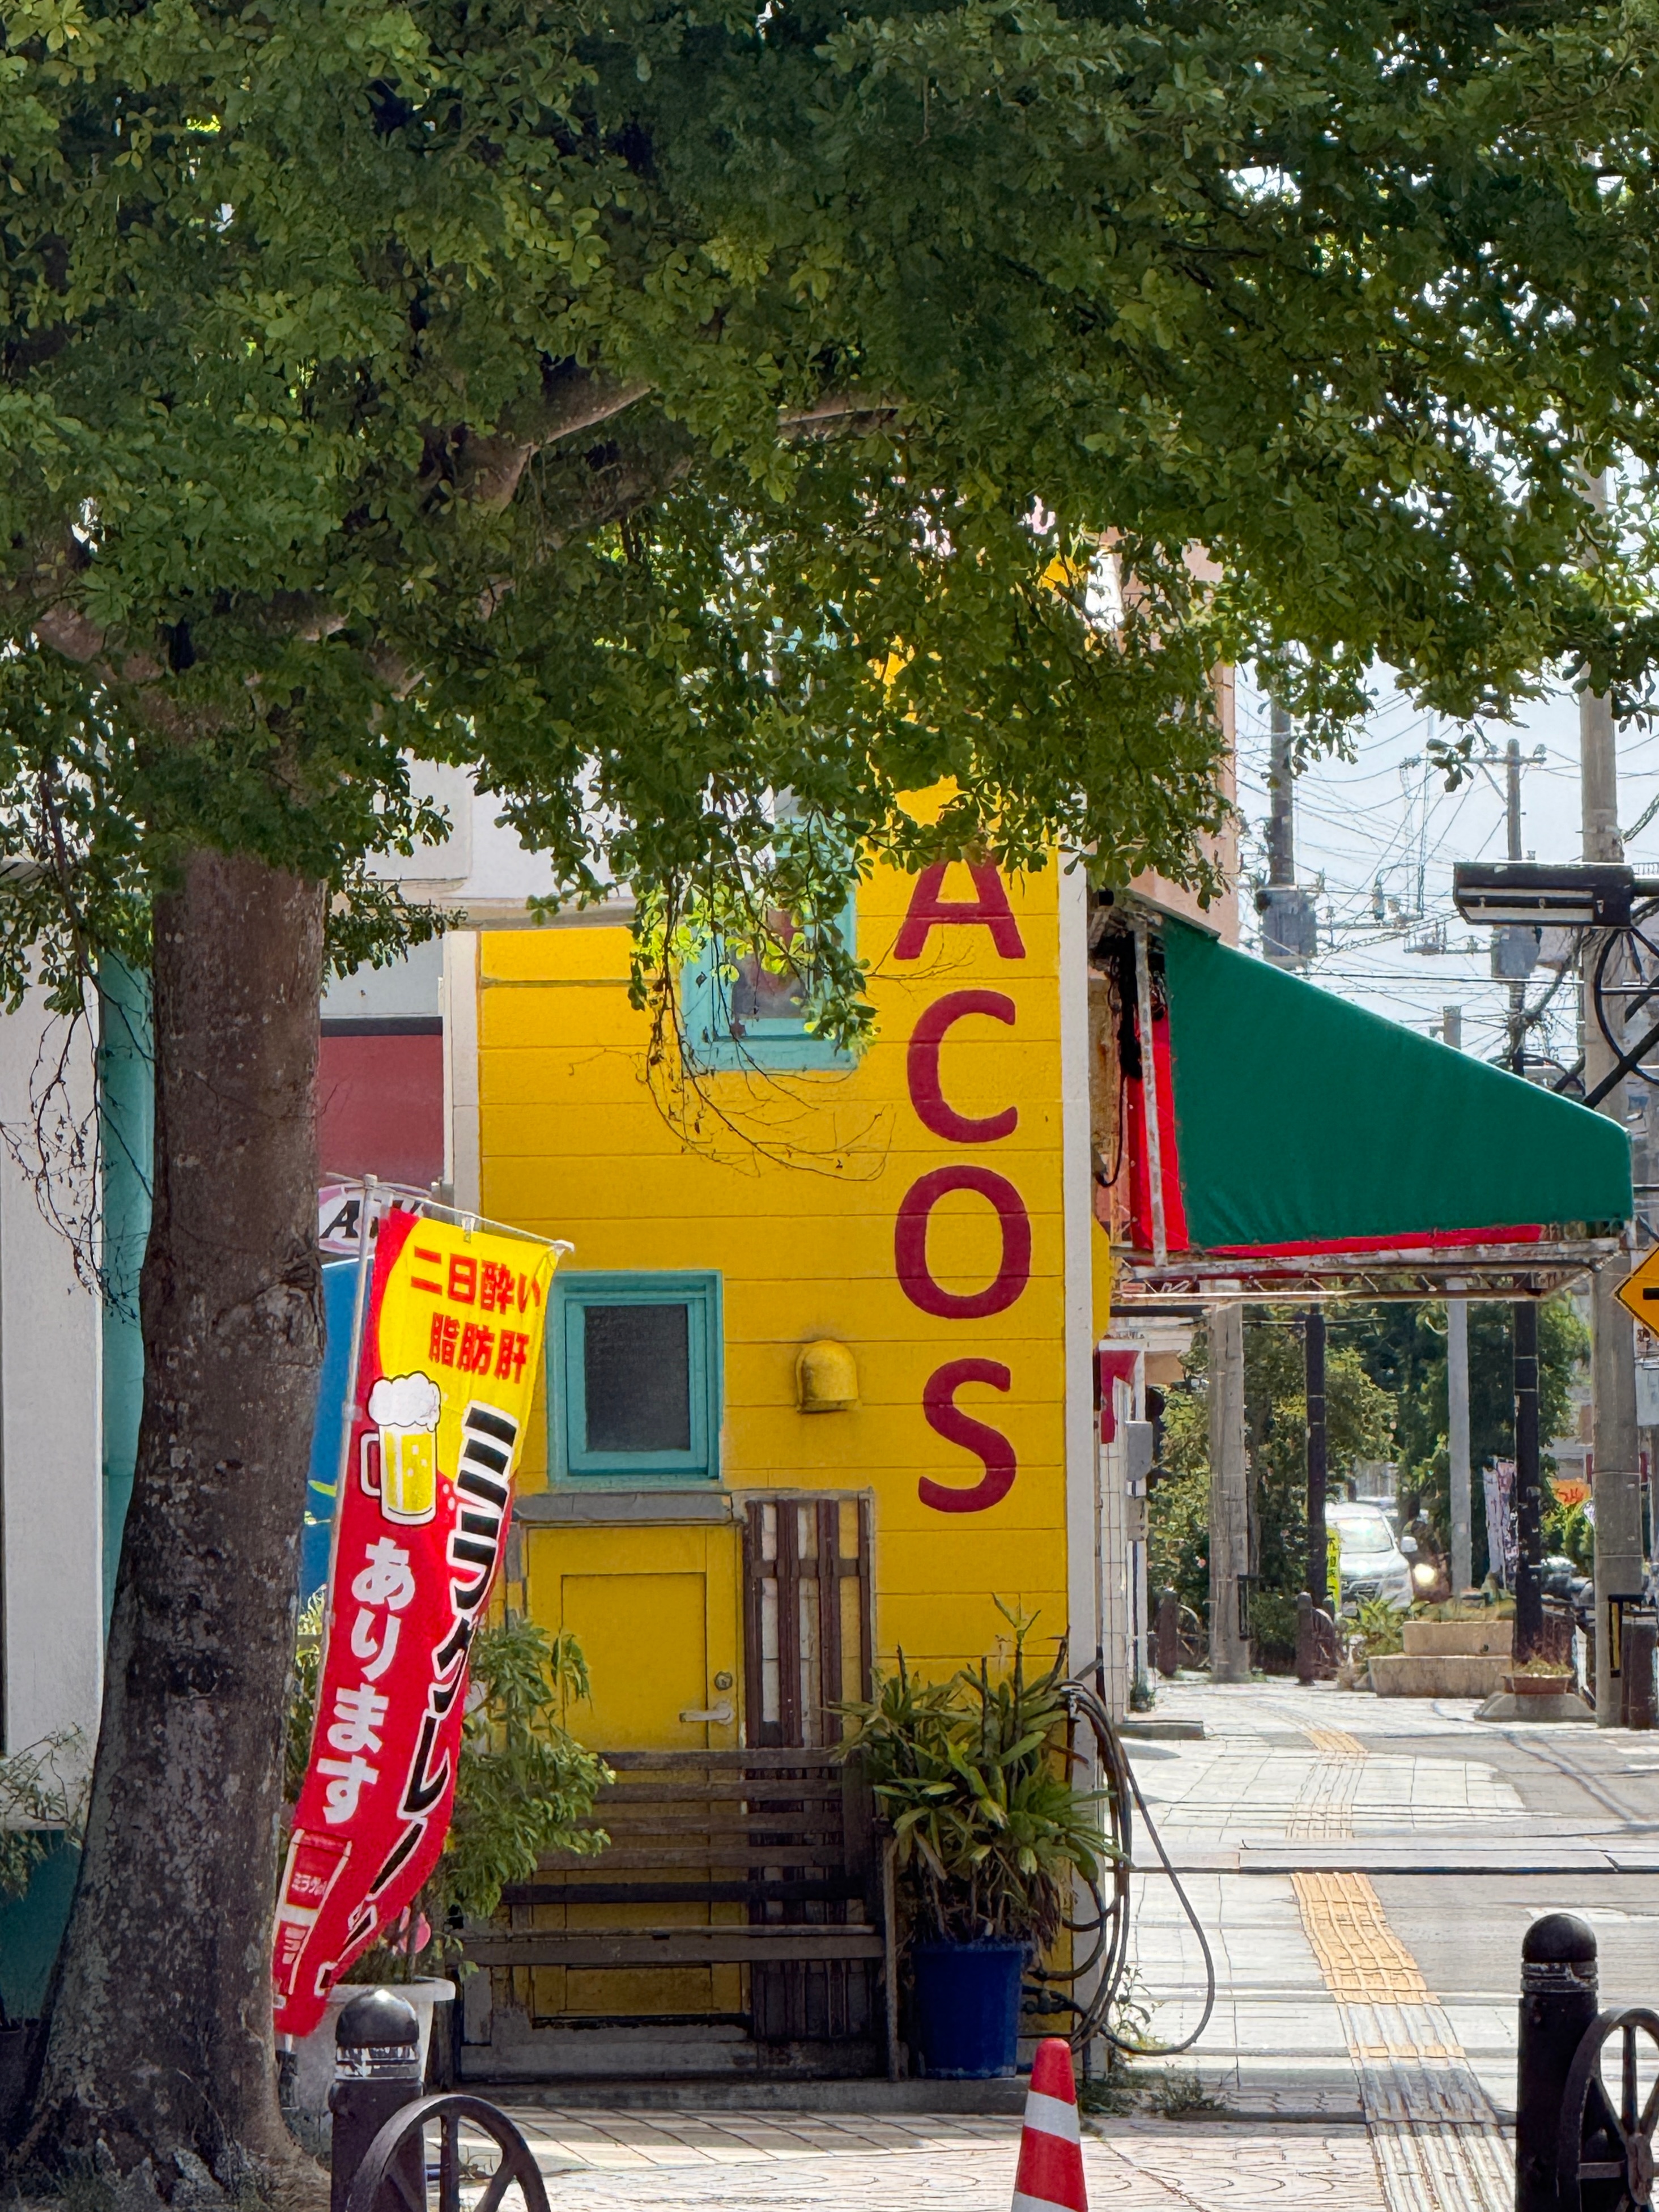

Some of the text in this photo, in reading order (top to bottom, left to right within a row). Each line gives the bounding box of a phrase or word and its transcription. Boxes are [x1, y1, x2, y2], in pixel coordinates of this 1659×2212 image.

[894, 844, 1031, 1513] ACOS
[410, 1245, 541, 1315] 二日酔い
[428, 1312, 531, 1384] 脂肪肝
[316, 1536, 416, 1824] あります
